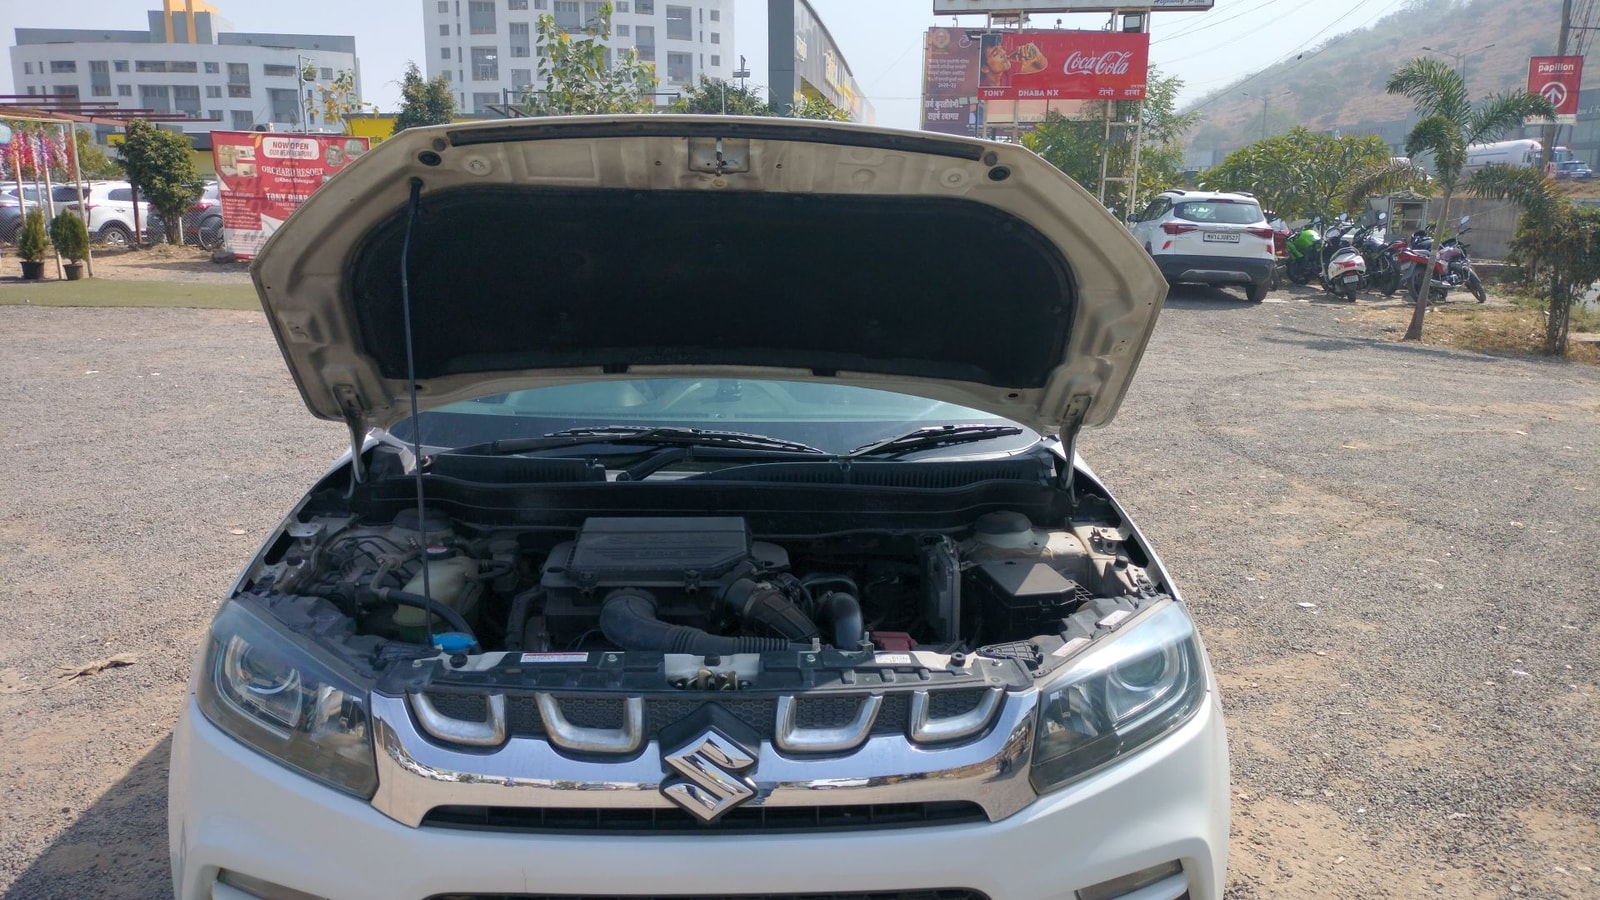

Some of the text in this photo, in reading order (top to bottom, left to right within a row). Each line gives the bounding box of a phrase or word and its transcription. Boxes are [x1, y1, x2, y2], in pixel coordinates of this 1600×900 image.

[1538, 63, 1574, 73] papillon
[1018, 89, 1045, 97] DHABA
[1046, 89, 1059, 97] NX
[272, 141, 309, 150] NOW OPEN
[261, 165, 324, 178] ORCHARD RESORT
[265, 192, 309, 202] TONY DHAB
